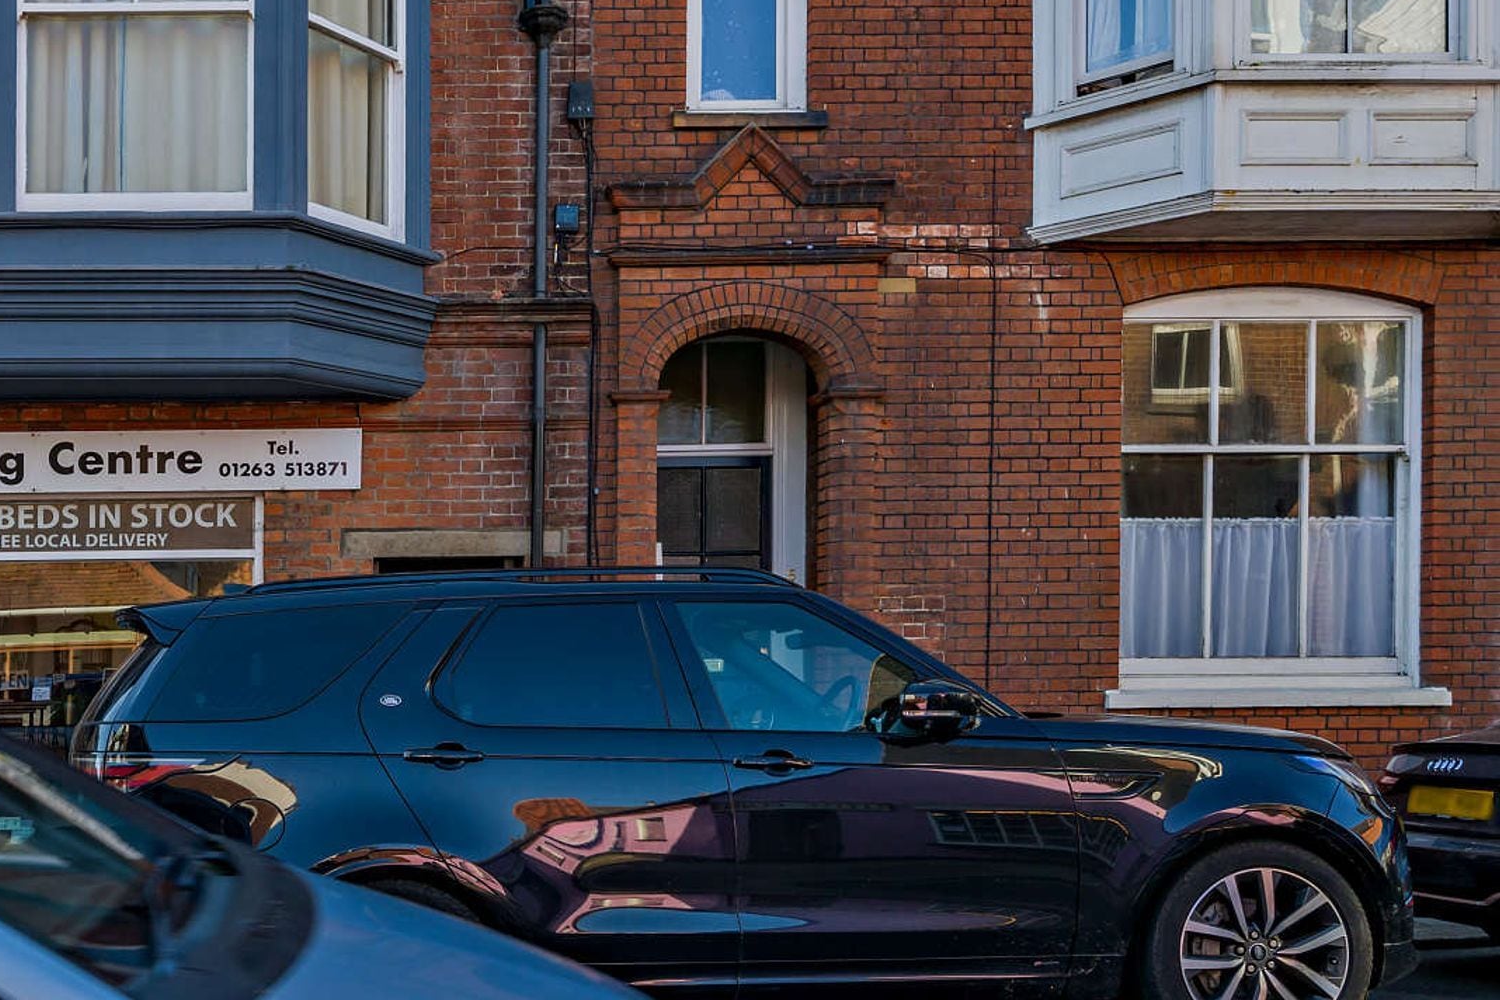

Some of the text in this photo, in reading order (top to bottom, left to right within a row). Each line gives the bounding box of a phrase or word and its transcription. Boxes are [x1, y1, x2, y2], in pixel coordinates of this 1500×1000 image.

[266, 440, 300, 456] Tel.
[49, 441, 203, 476] Centre
[218, 461, 348, 478] 01263 513871
[89, 503, 122, 529] IN
[130, 502, 237, 529] STOCK
[25, 534, 81, 548] LOCAL
[86, 533, 170, 548] DELIVERY
